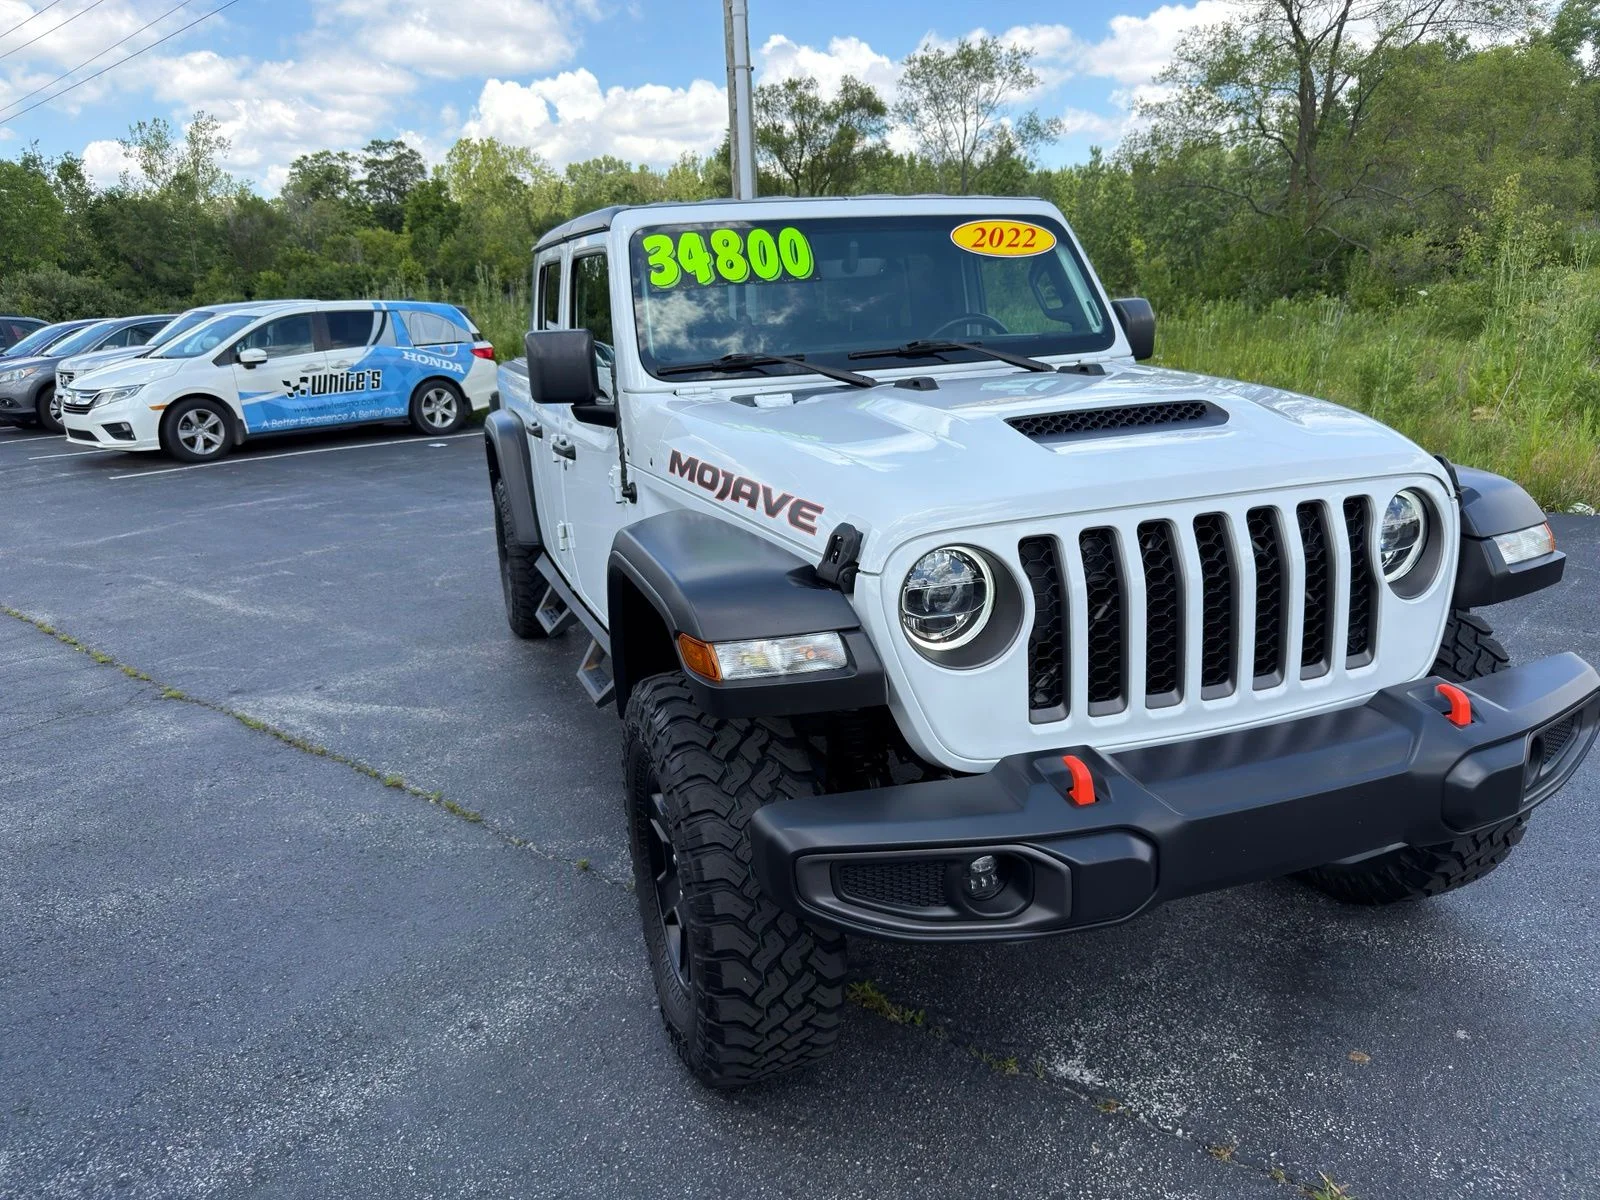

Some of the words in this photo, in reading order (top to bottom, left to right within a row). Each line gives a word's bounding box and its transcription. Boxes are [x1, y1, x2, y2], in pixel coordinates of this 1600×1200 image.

[971, 227, 1036, 248] 2022
[642, 226, 814, 289] 34800
[402, 351, 465, 374] HONDA
[311, 370, 382, 395] White's
[261, 420, 270, 429] A
[271, 418, 298, 428] Better
[300, 412, 348, 425] Experience
[349, 411, 358, 420] A
[359, 408, 384, 418] Better
[385, 407, 405, 416] Price
[668, 449, 825, 536] MOJAVE
